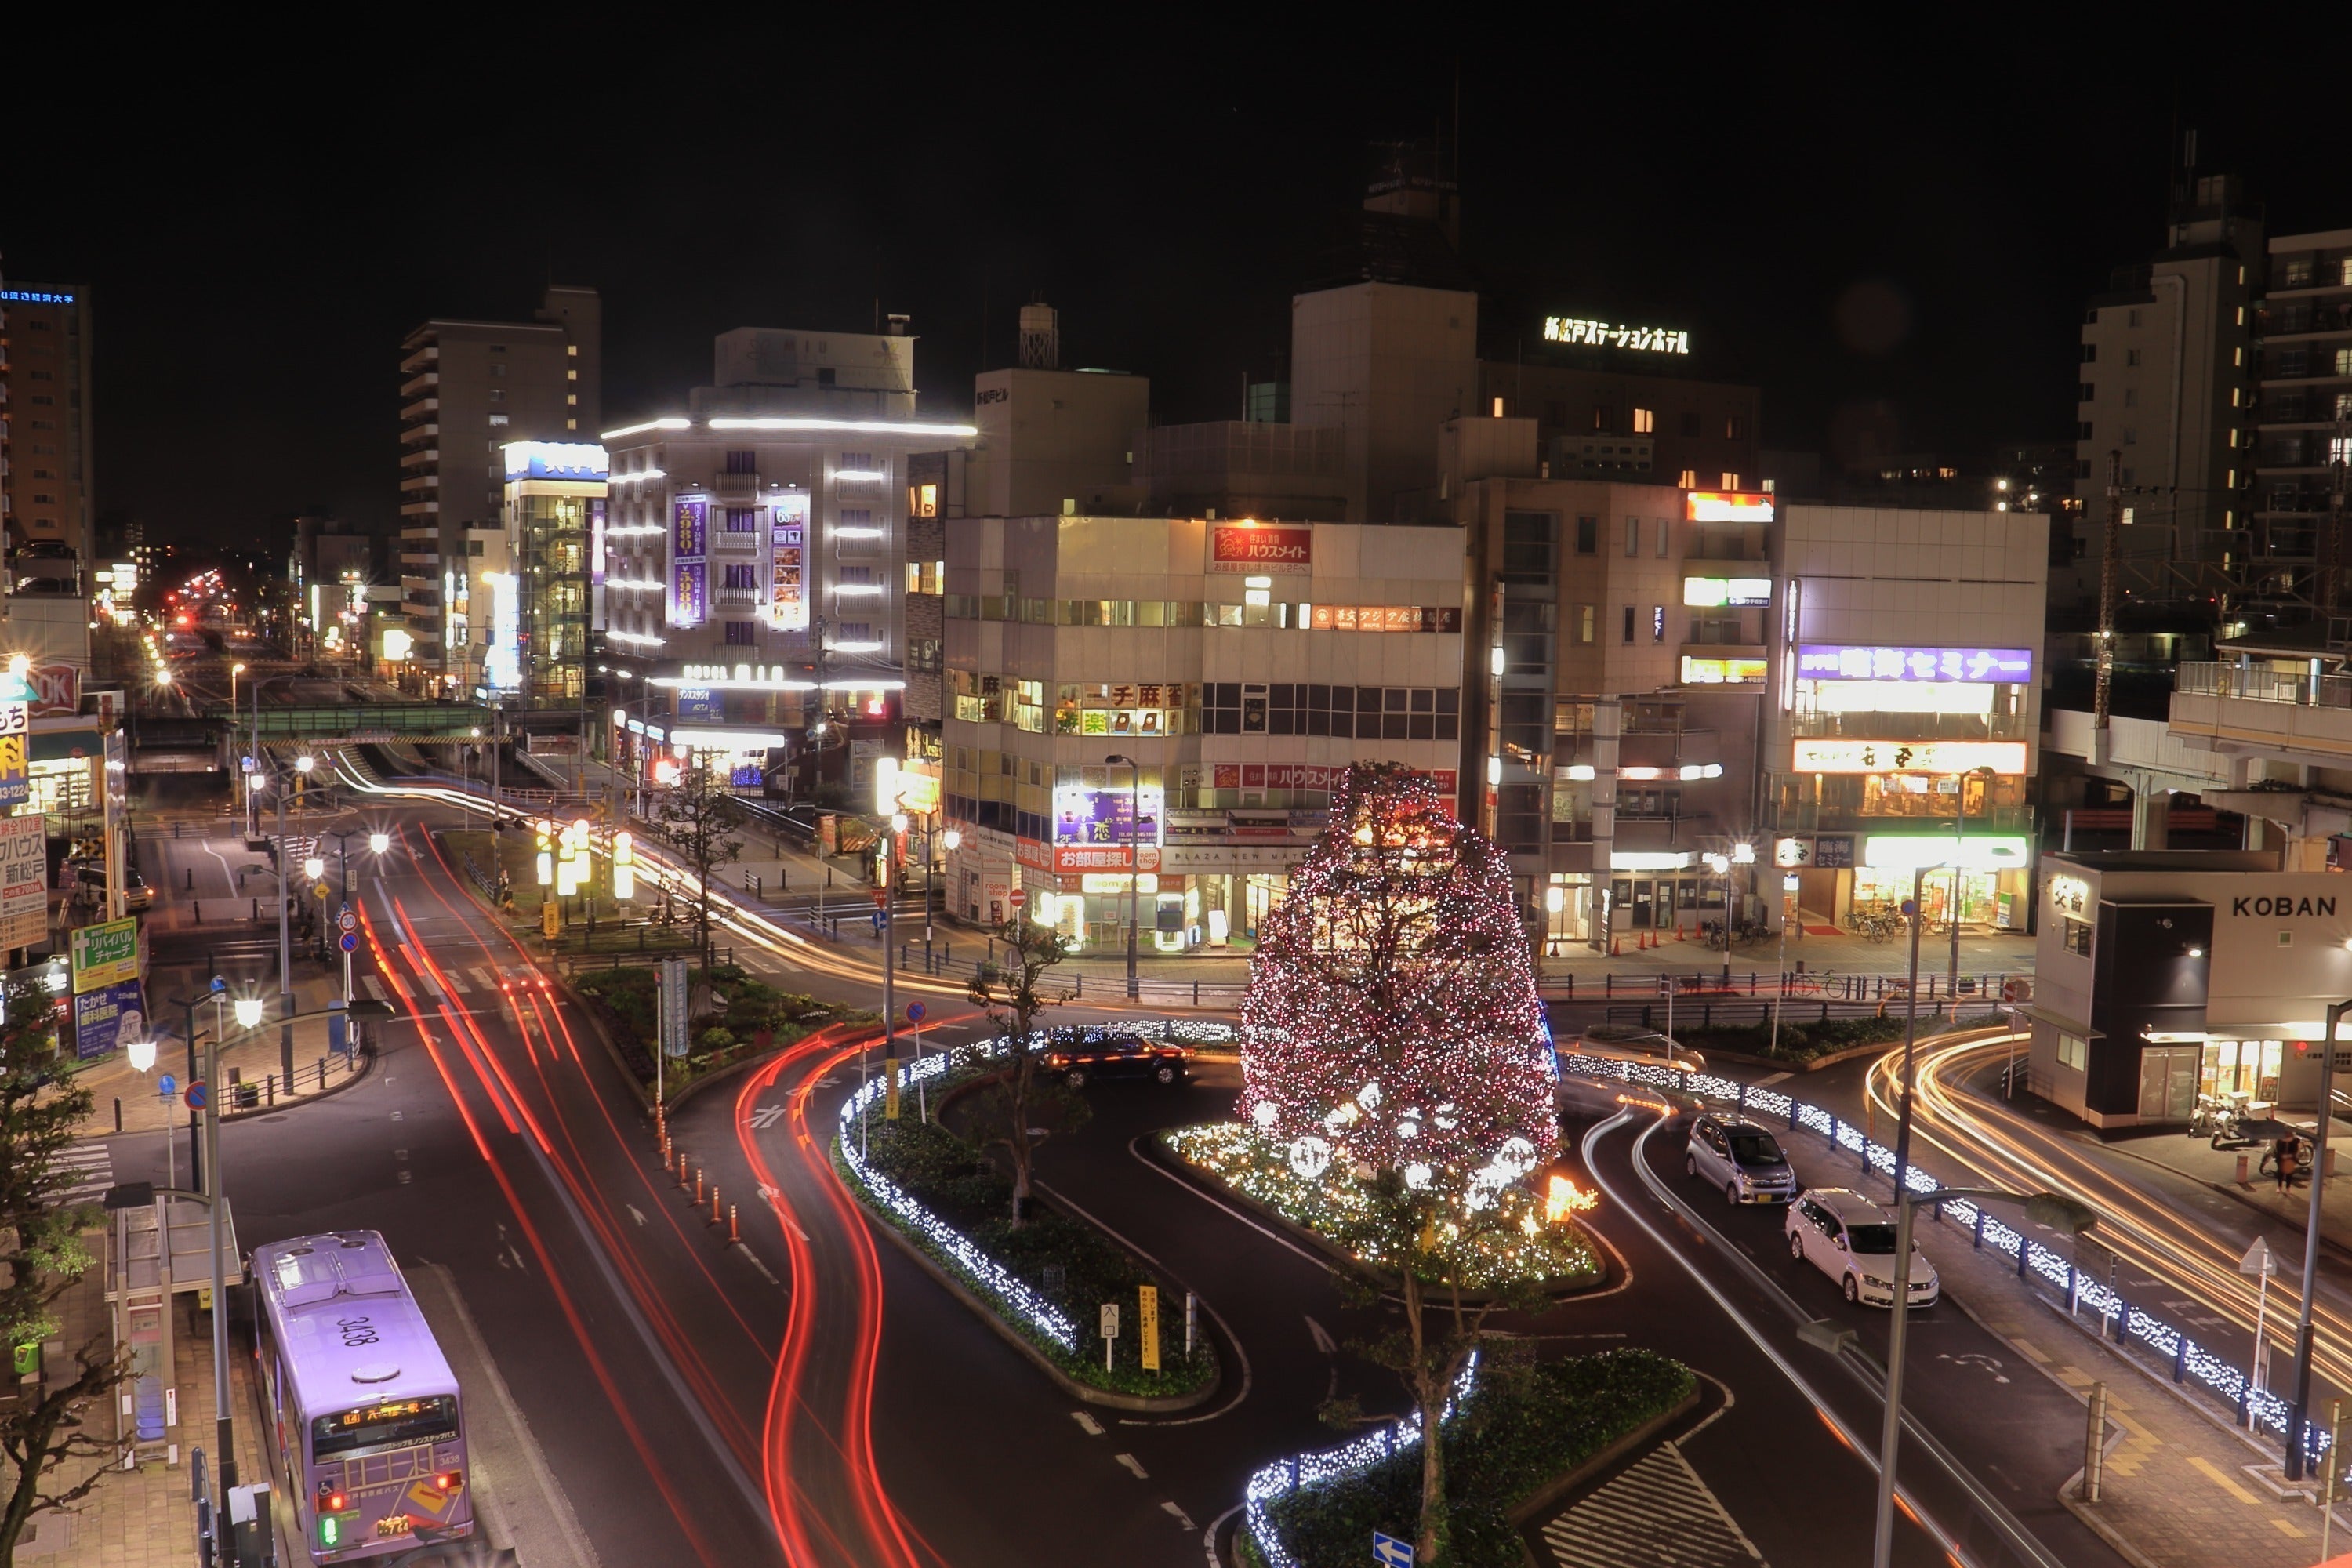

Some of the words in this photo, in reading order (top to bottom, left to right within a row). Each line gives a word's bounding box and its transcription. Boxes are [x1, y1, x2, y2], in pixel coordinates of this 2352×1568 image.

[1544, 316, 1689, 354] 新松戸ステーションホテル
[977, 388, 1009, 405] 新松戸ビル
[1248, 545, 1307, 558] ハウスメイト
[982, 675, 1000, 720] 麻雀
[1819, 840, 1849, 854] 臨海
[1061, 851, 1133, 868] お部屋探し
[1817, 854, 1851, 867] セミナー
[6, 858, 45, 884] 新松戸
[989, 889, 1008, 898] shop
[2233, 897, 2336, 916] KOBAN
[344, 916, 354, 926] 30
[90, 930, 133, 951] リバイバル
[96, 943, 131, 964] チャーチ
[81, 1004, 118, 1027] 歯科医院
[1103, 1306, 1116, 1336] 入口
[337, 1317, 379, 1346] 3438
[439, 1454, 461, 1466] 3438
